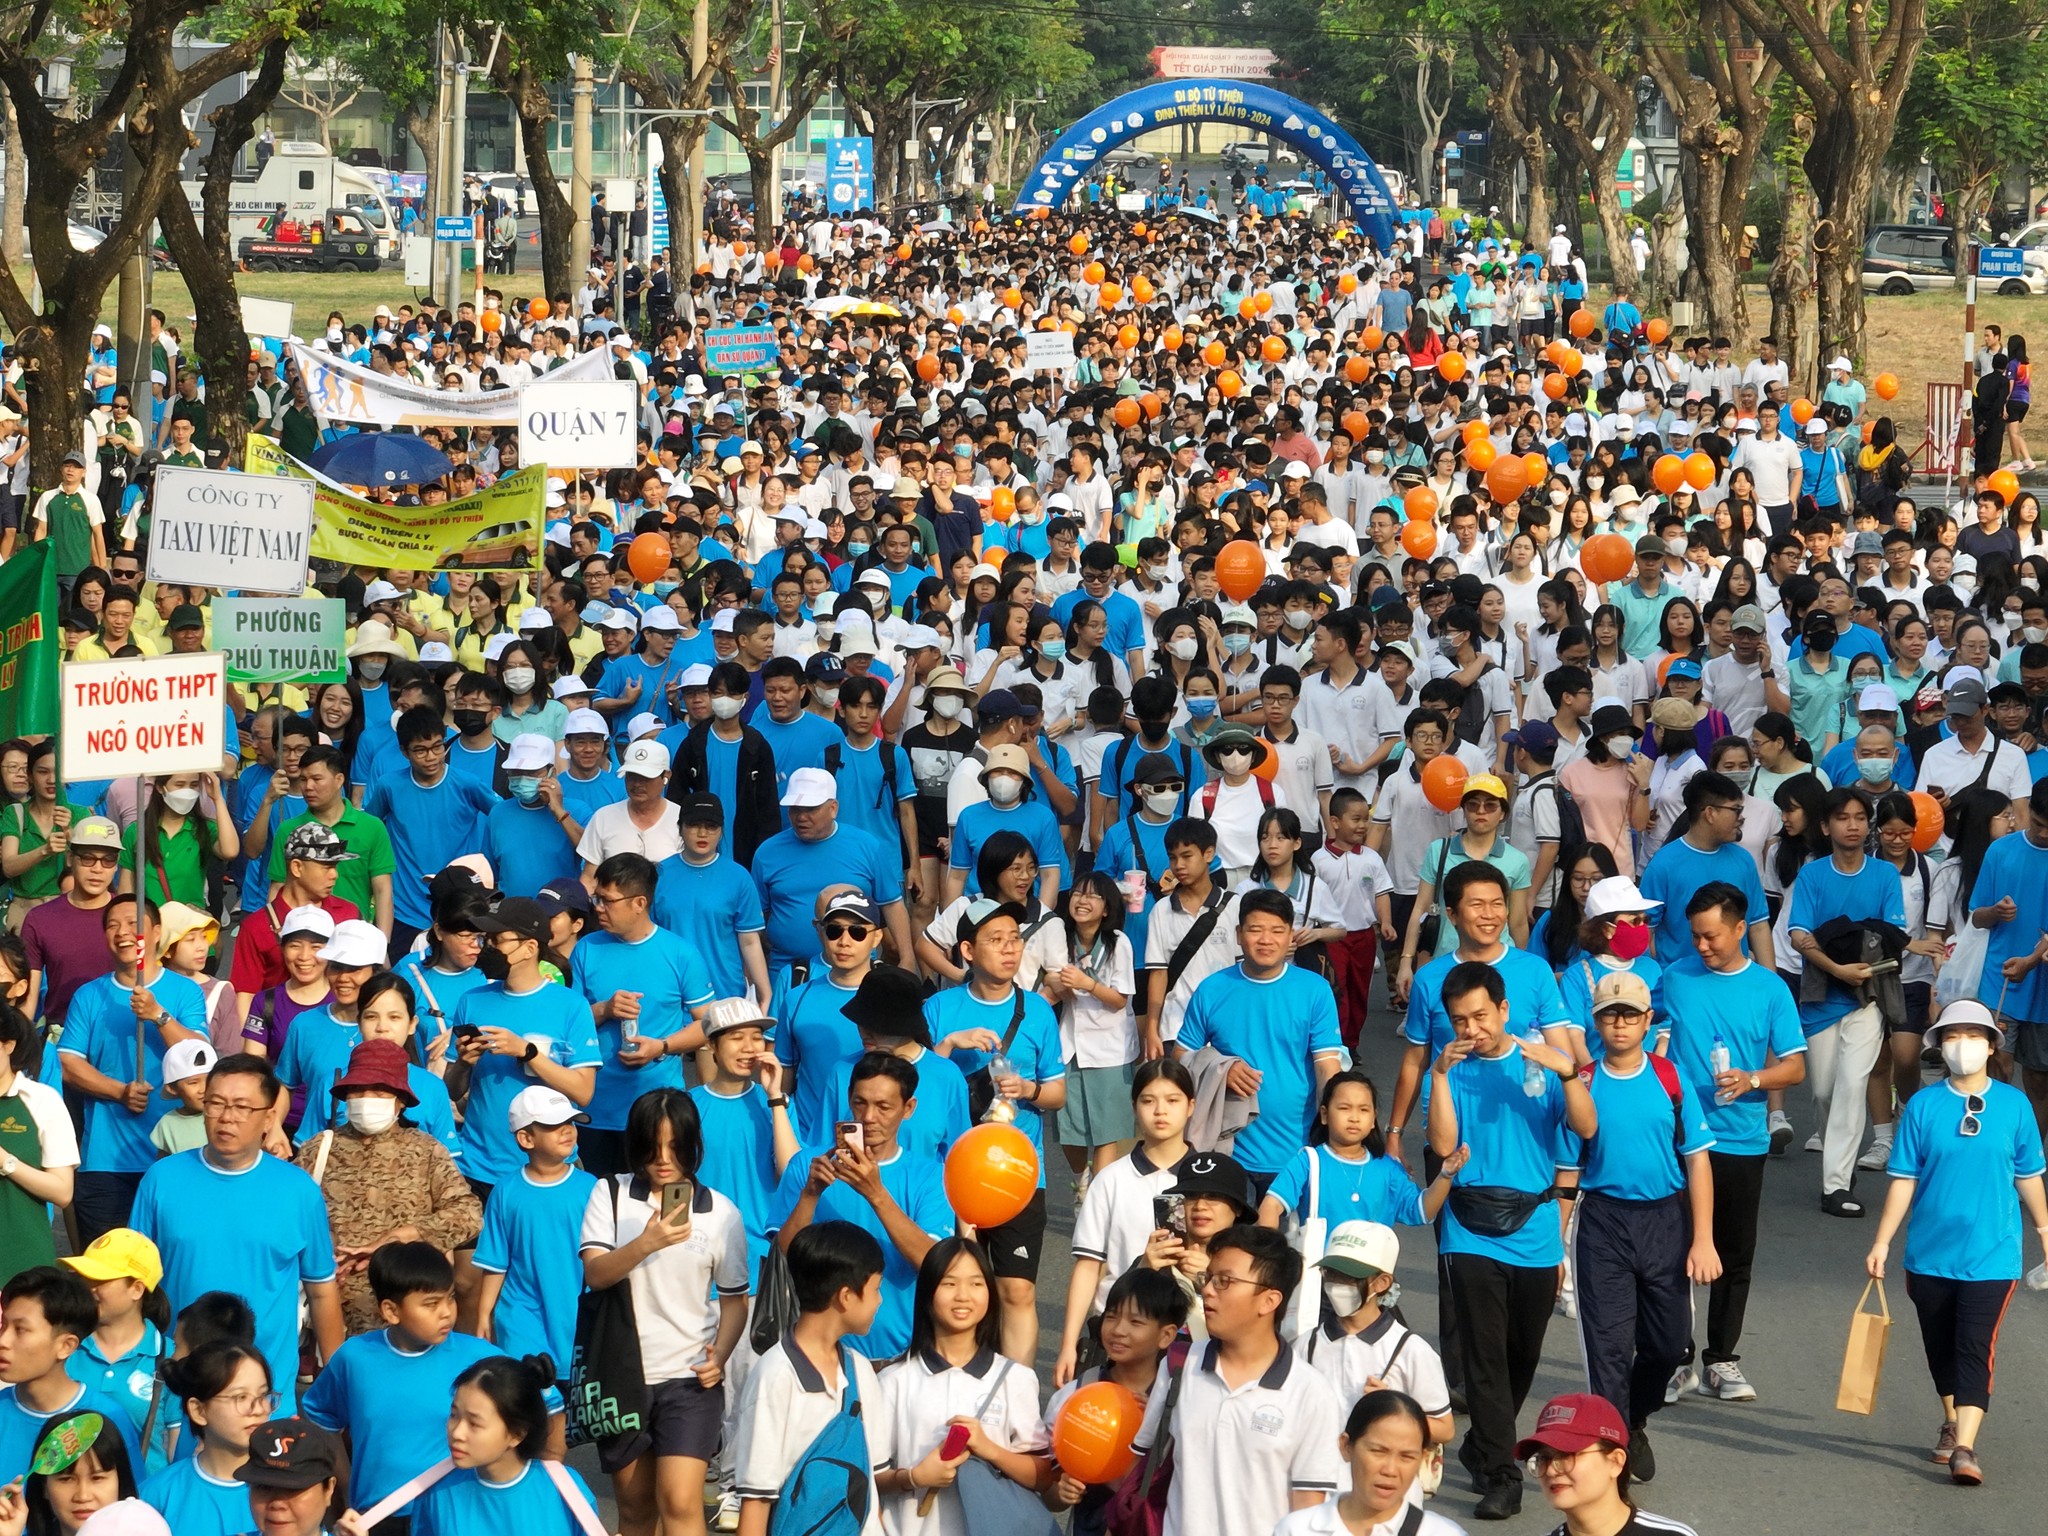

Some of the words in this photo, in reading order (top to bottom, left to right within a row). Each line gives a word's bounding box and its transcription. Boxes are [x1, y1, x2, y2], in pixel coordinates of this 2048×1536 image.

[1173, 61, 1191, 73] TẾT
[1193, 62, 1218, 74] GIÁP
[1220, 62, 1244, 74] THÌN
[1175, 90, 1186, 103] ĐI
[1188, 87, 1201, 103] BỘ
[1203, 86, 1216, 101] TỪ
[1218, 88, 1244, 104] THIỆN
[1155, 107, 1177, 122] ĐINH
[1179, 104, 1204, 118] THIỆN
[1205, 103, 1216, 115] LÝ
[1218, 102, 1236, 117] LẦN
[1982, 262, 2001, 273] PHẠM
[742, 347, 759, 364] QUẬN
[761, 350, 766, 360] 7
[528, 407, 605, 442] QUẬN
[615, 411, 628, 435] 7
[187, 484, 248, 507] CÔNG
[255, 493, 283, 510] TY
[463, 514, 484, 523] THIỆN
[159, 519, 204, 553] TAXI
[208, 520, 254, 565] VIỆT
[256, 528, 302, 562] NAM
[398, 541, 420, 551] CHIA
[236, 606, 322, 633] PHƯỜNG
[268, 644, 338, 675] THUẬN
[75, 670, 158, 707] TRƯỜNG
[165, 673, 217, 700] THPT
[87, 719, 127, 754] NGÔ
[136, 709, 204, 754] QUYỀN
